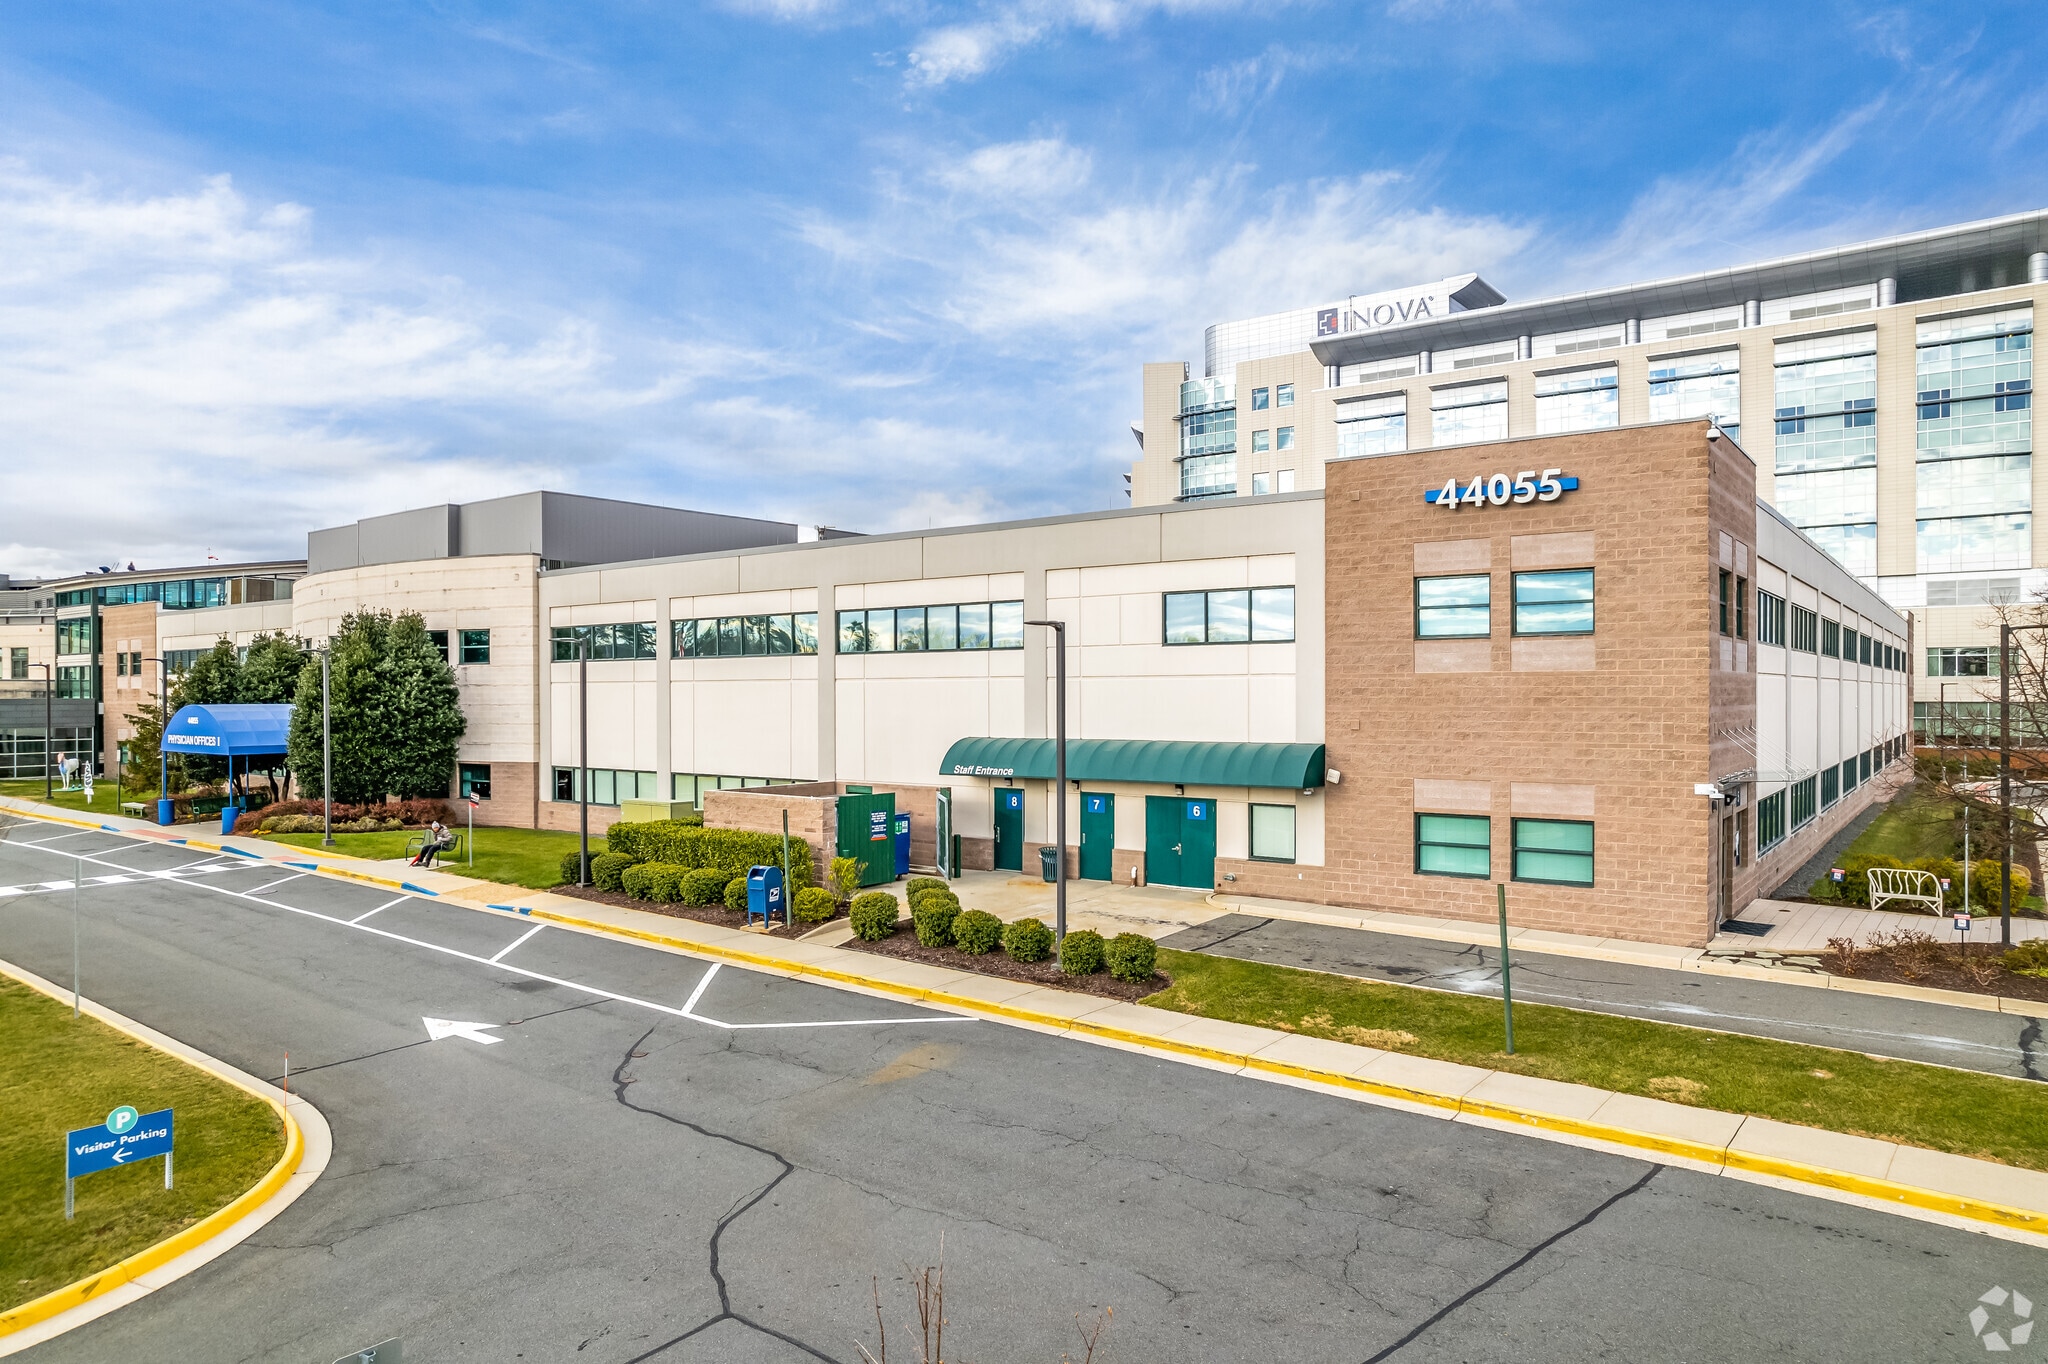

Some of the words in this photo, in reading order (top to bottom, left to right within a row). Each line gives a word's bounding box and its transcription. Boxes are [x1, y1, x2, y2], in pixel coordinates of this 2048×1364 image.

[1435, 467, 1563, 510] 44055
[167, 734, 194, 746] PHYSICIAN
[194, 735, 217, 747] OFFICES
[953, 764, 975, 775] Staff
[975, 765, 1014, 776] Entrance
[1011, 796, 1018, 807] 8
[1093, 799, 1100, 810] 7
[1193, 805, 1201, 817] 6
[115, 1111, 131, 1130] P
[75, 1140, 117, 1156] Visitor
[120, 1128, 167, 1145] Parking
